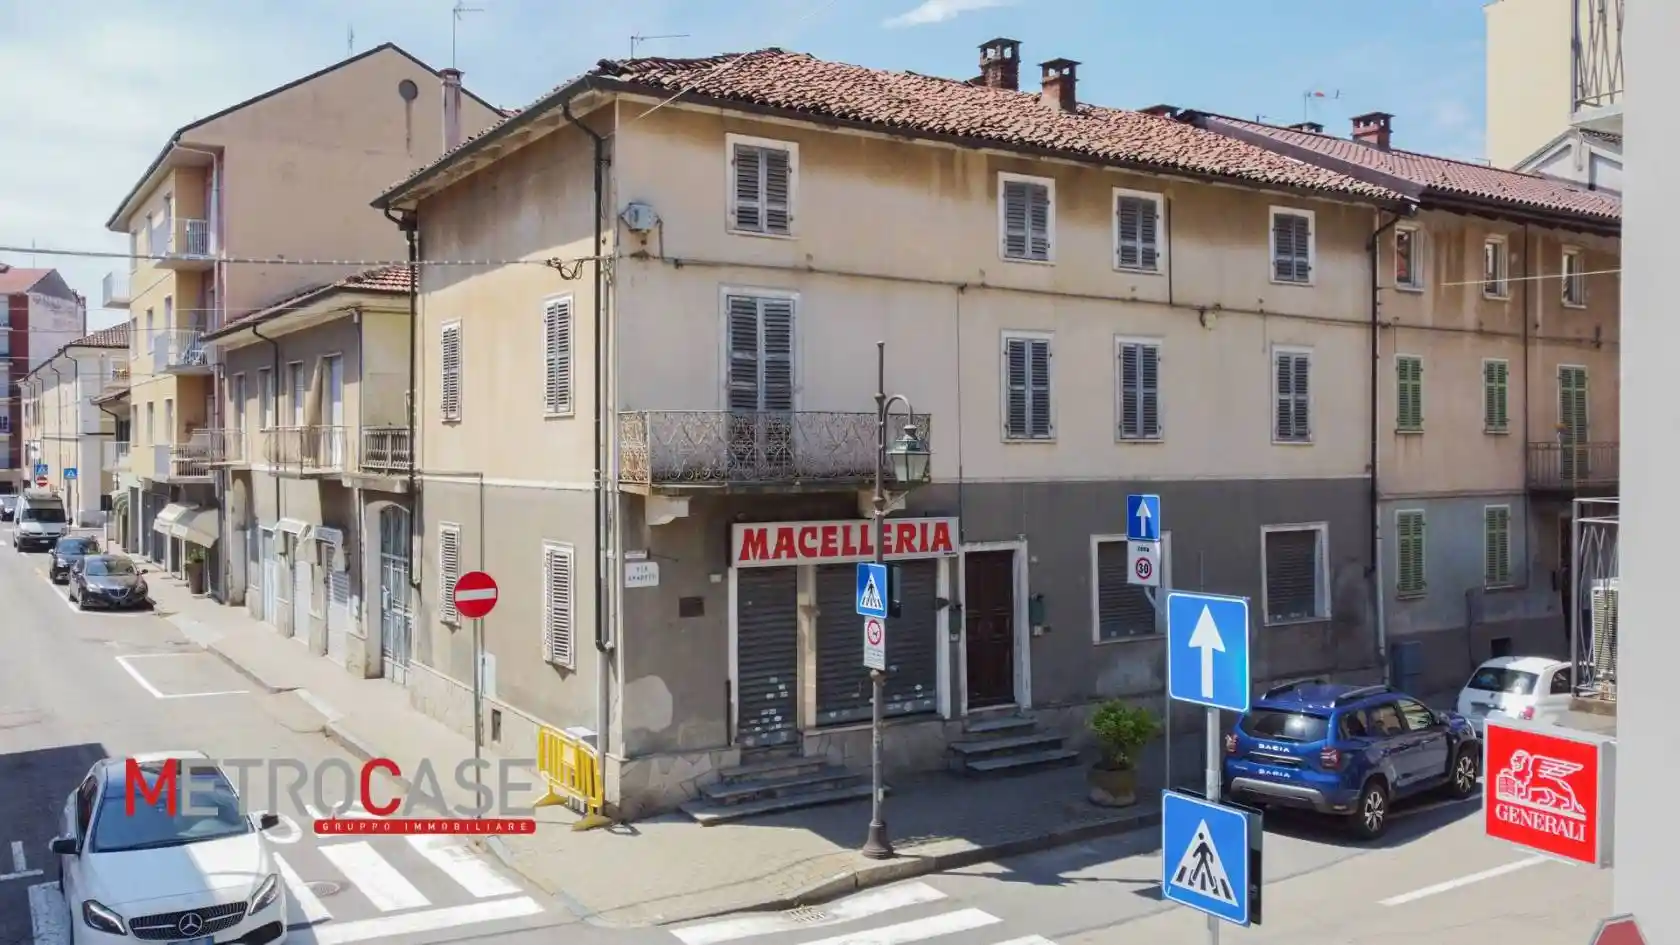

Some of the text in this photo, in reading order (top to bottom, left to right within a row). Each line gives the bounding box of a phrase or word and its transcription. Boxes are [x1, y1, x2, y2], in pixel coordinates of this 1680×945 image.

[738, 522, 953, 561] MACELLERIA
[1139, 563, 1149, 574] 30
[1258, 743, 1290, 753] DACIA
[1495, 803, 1586, 842] GENERALI
